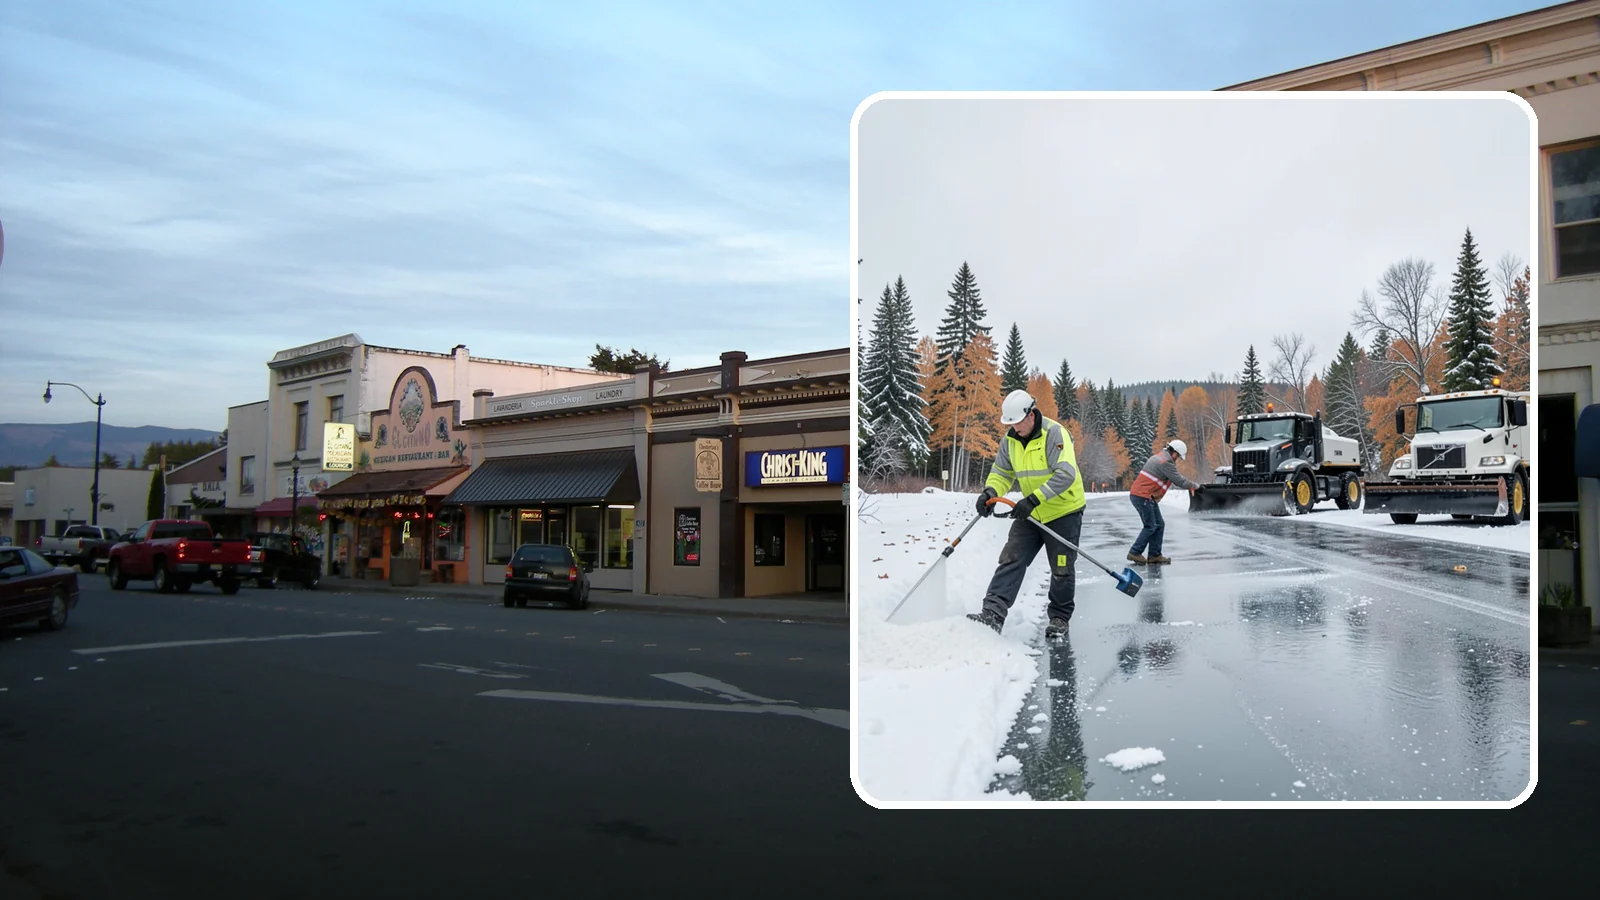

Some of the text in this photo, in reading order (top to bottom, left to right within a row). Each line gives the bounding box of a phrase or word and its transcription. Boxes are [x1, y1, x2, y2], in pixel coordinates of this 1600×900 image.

[493, 402, 522, 412] LAVANDERIA
[561, 394, 583, 405] Shop
[595, 389, 624, 400] LAUNDRY
[373, 455, 397, 464] MEXICAN
[398, 451, 433, 462] RESTAURANT
[438, 450, 450, 459] BAR
[761, 450, 828, 478] CHRIST KING
